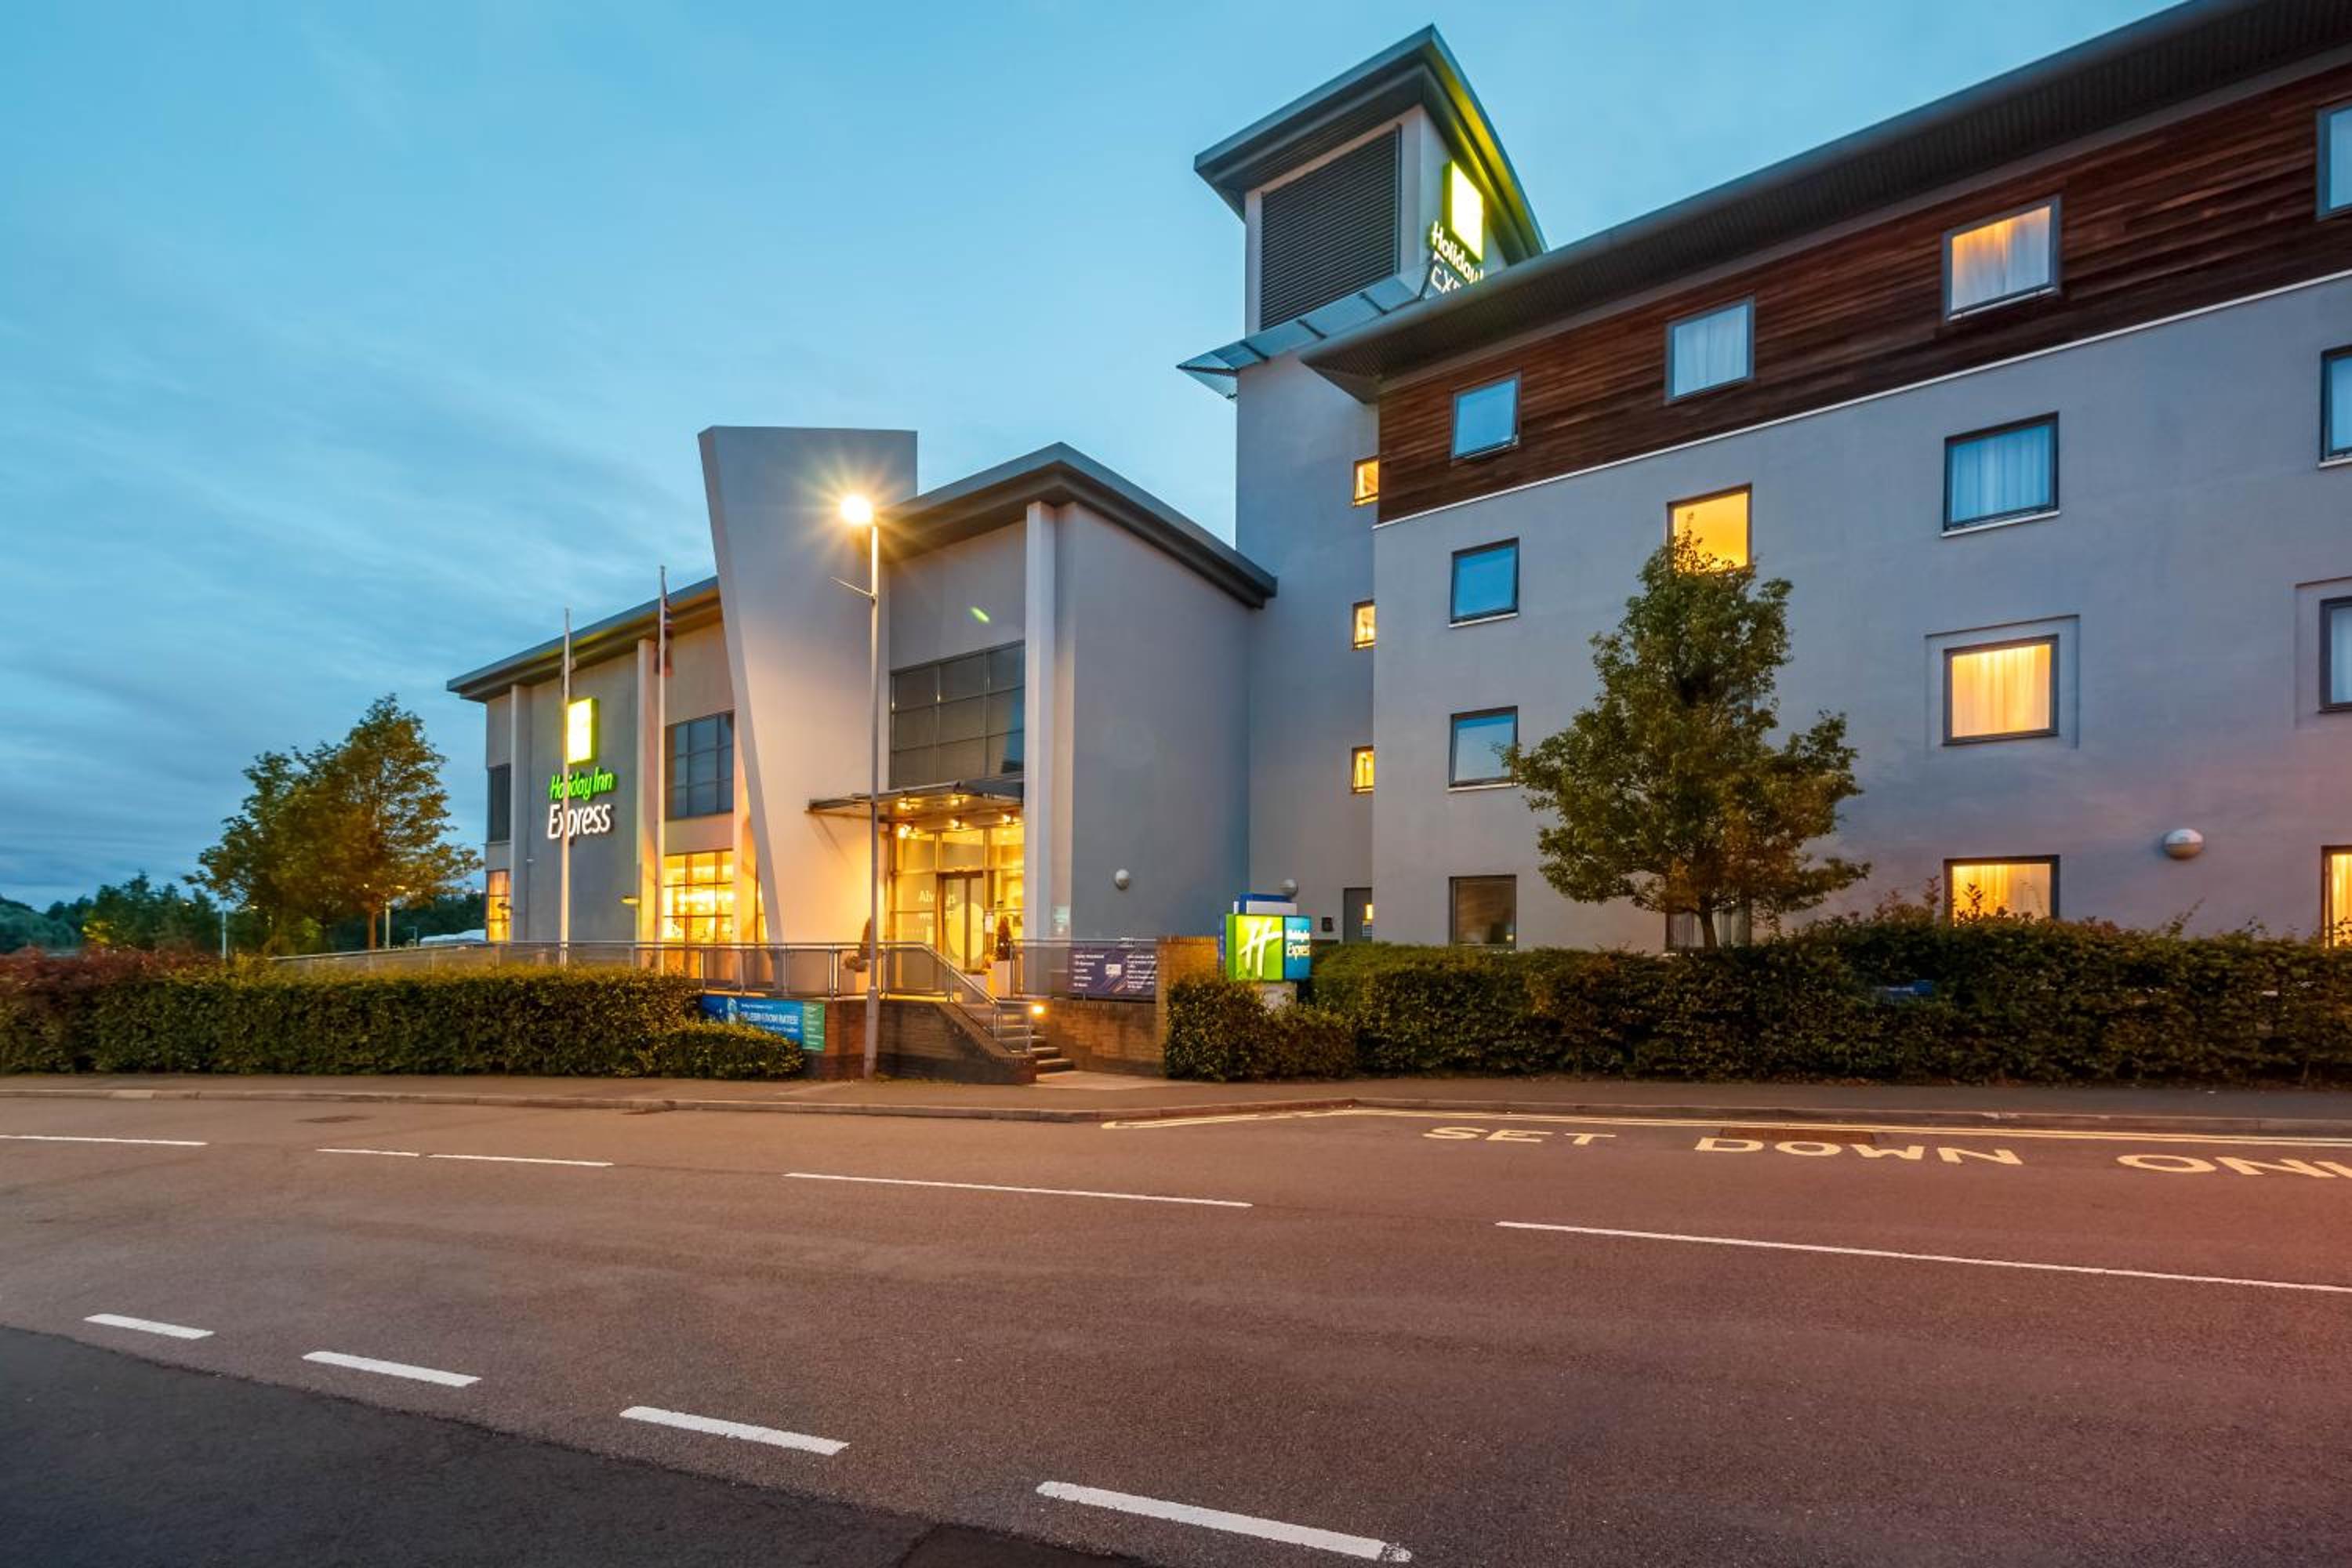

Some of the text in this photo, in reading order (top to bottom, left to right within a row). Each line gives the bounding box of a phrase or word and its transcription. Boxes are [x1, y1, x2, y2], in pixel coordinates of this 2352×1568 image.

[550, 766, 613, 801] Hoiday Inn
[1422, 1127, 1617, 1145] SET
[1694, 1137, 2024, 1165] DOWN
